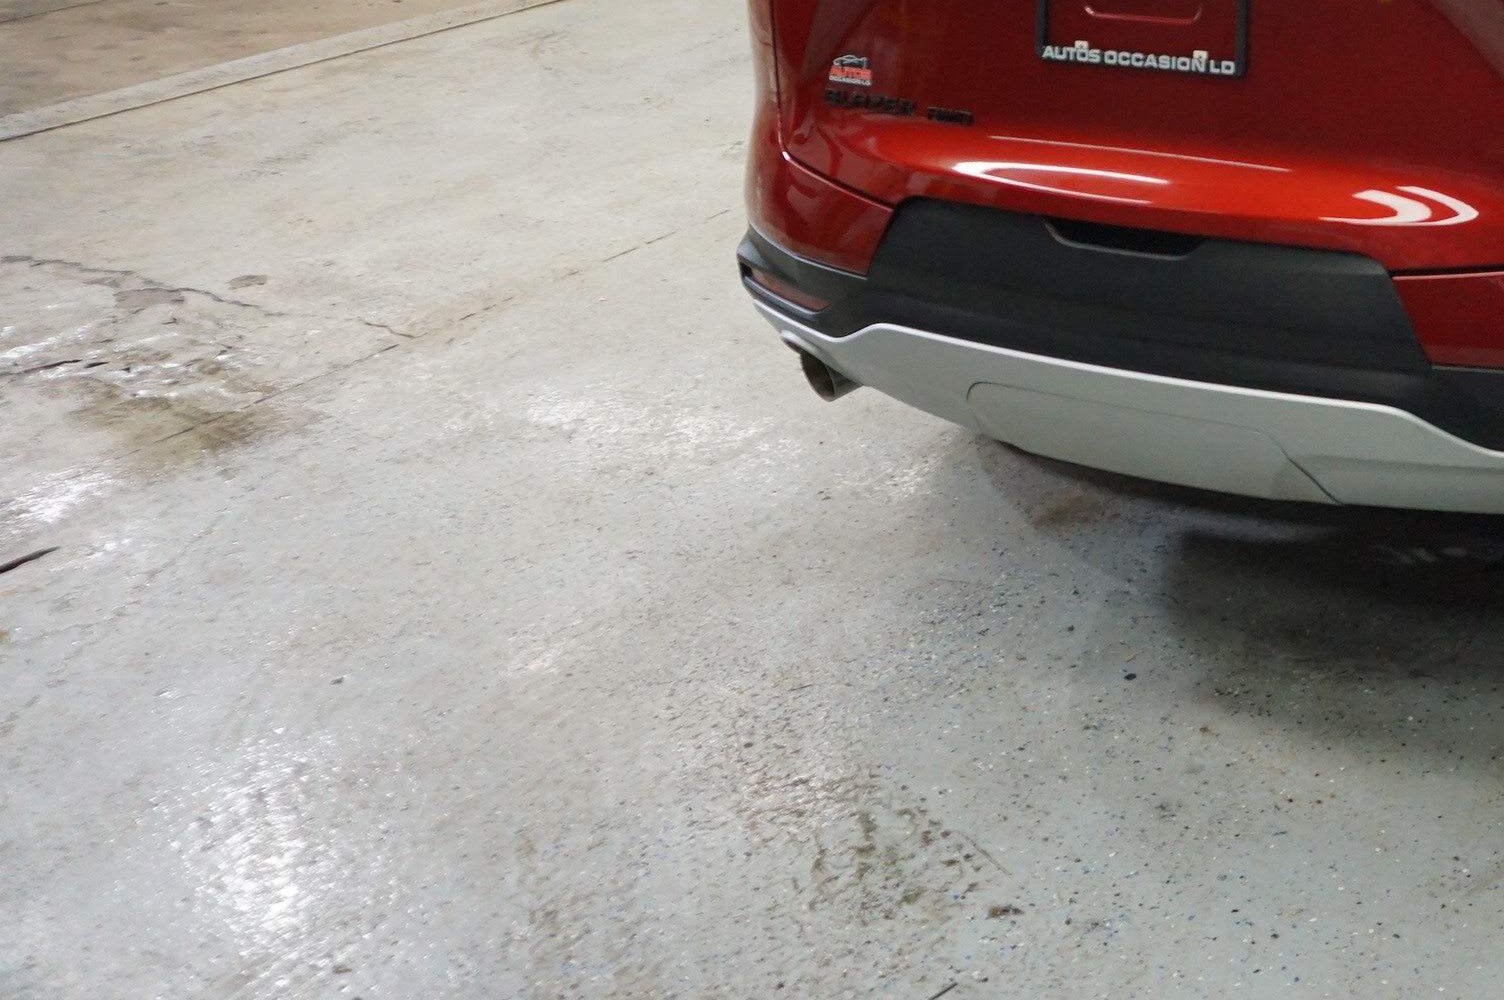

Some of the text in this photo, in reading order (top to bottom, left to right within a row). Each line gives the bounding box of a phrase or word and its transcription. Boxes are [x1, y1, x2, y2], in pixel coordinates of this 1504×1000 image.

[1042, 45, 1236, 75] AUTOS OCCASION LD
